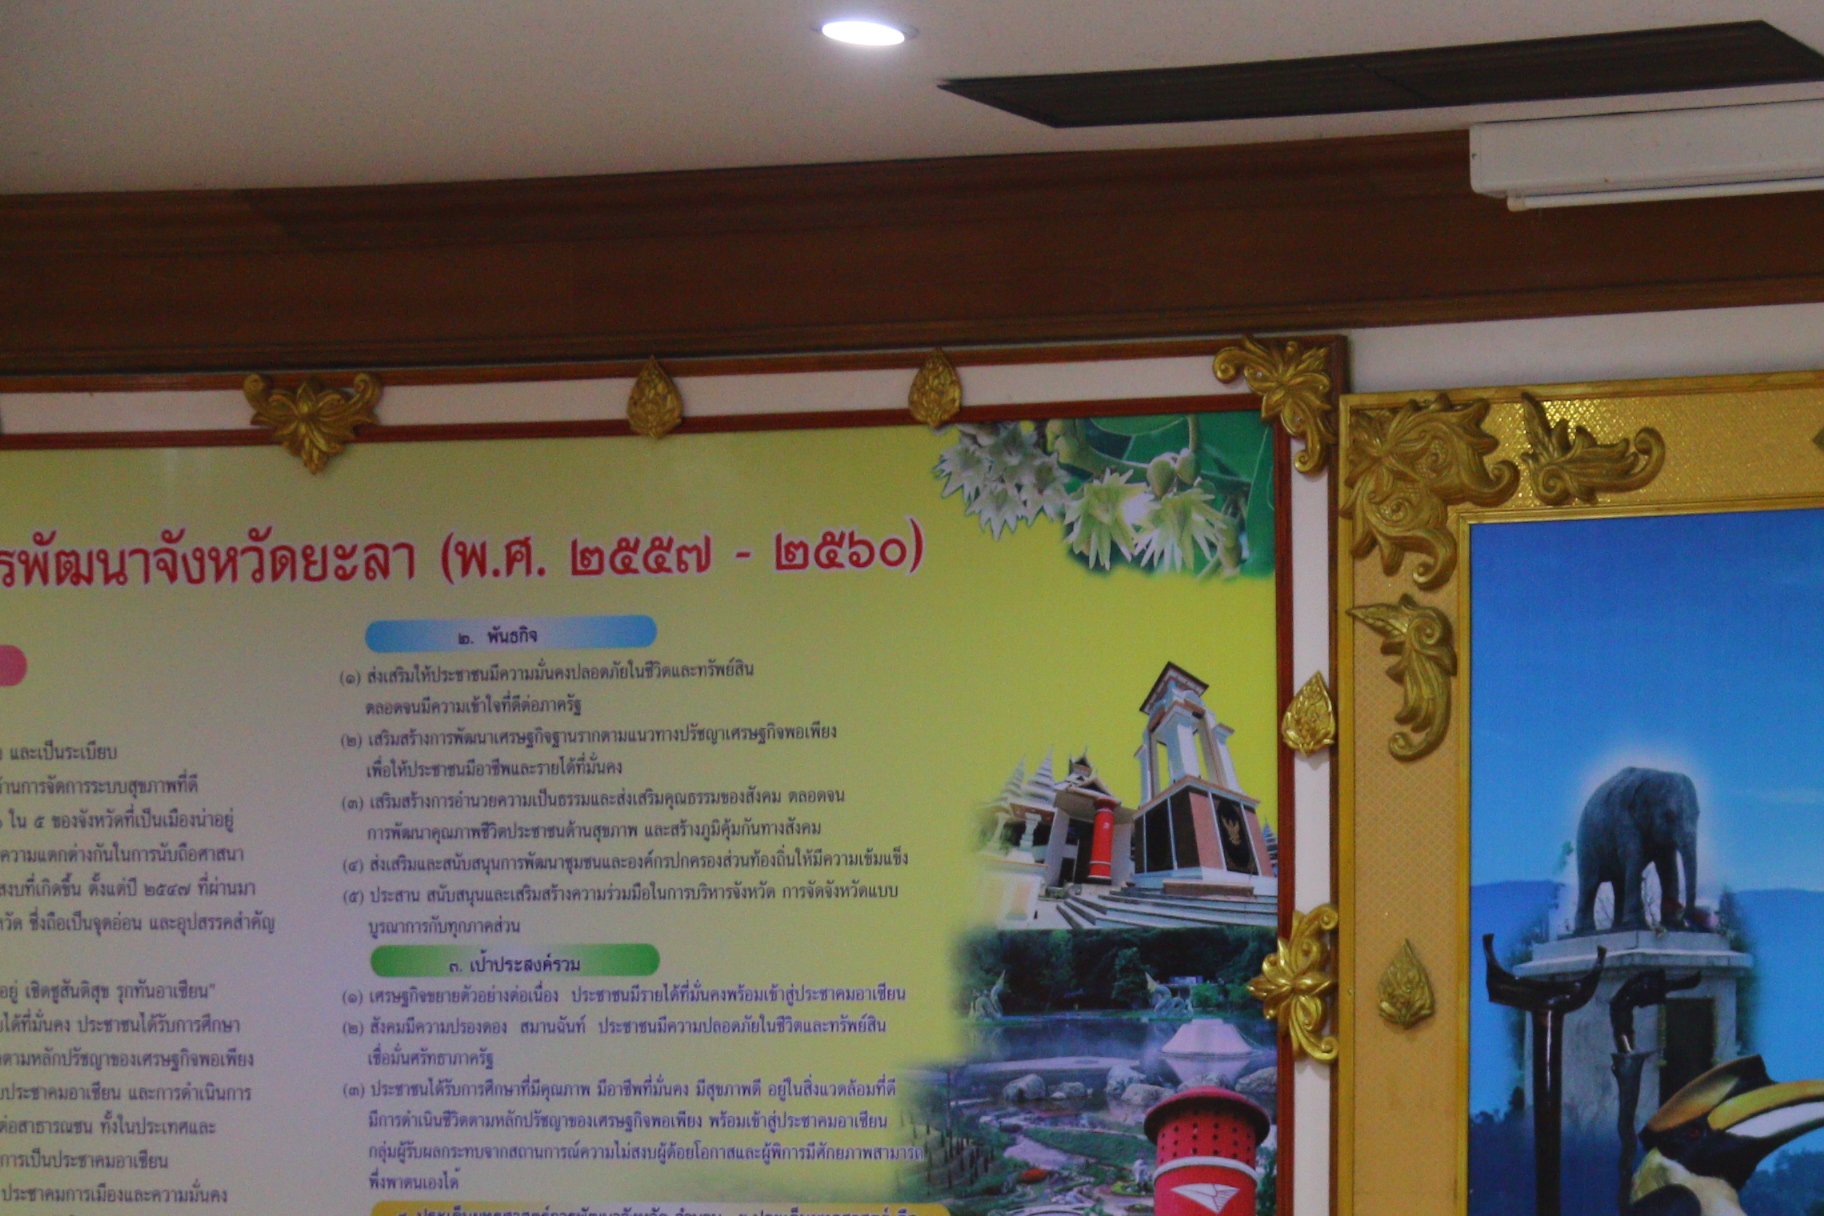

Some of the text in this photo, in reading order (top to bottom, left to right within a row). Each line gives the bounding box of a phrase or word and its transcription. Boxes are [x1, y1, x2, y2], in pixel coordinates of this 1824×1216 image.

[570, 533, 714, 578] ๒๕๕๗
[487, 626, 537, 644] พันธกิจ
[366, 691, 581, 716] ตลอดจนมีความเข้าใจที่ดีต่อภาครัฐ
[10, 739, 117, 760] และเป็นระเบียบ
[367, 753, 622, 778] เพื่อให้ประชาชนมีอาชีพและรายได้ที่มั่นคง
[788, 790, 845, 803] ตลอดจน
[8, 808, 27, 829] ใน
[52, 803, 234, 832] ของจังหวัดที่เป็นเมืองน่าอยู่
[368, 817, 821, 844] การพัฒนาคุณภาพชีวิตประชาชนด้านสุขภาพ และสร้างภูมิคุ้มกันทางสังคม
[88, 873, 137, 896] ตั้งแต่ปี
[197, 872, 256, 896] ที่ผ่านมา
[370, 887, 420, 903] ประสาน
[783, 880, 898, 899] การจัดจังหวัดแบบ
[29, 909, 142, 937] ซึ่งถือเป็นจุดอ่อน
[149, 910, 275, 936] และอุปสรรคสำคัญ
[368, 916, 520, 939] บูรณาการกับทุกภาคส่วน
[470, 949, 580, 972] เป้าประสงค์รวม
[25, 979, 109, 1004] เชิดชูสันติสุข
[370, 982, 559, 1007] เศรษฐกิจขยายตัวอย่างต่อเนื่อง
[77, 1012, 240, 1033] ประชาชนได้รับการศึกษา
[371, 1016, 507, 1034] สังคมมีความปรองดอง
[520, 1015, 586, 1034] สมานฉันท์
[599, 1014, 886, 1034] ประชาชนมีความปลอดภัยในชีวิตและทรัพย์สิน
[0, 1047, 254, 1072] ตามหลักปรัชญาของเศรษฐกิจพอเพียง
[368, 1044, 493, 1070] เชื่อมั่นศรัทธาภาครัฐ
[128, 1082, 251, 1101] และการดำเนินการ
[371, 1074, 590, 1101] ประชาชนได้รับการศึกษาที่มีคุณภาพ
[597, 1074, 689, 1096] มีอาชีพที่มั่นคง
[696, 1078, 761, 1101] มีสุขภาพดี
[768, 1074, 895, 1102] อยู่ในสิ่งแวดล้อมที่ดี
[100, 1110, 216, 1135] ทั้งในประเทศและ
[369, 1109, 887, 1133] มีการดำเนินชีวิตตามหลักปรัชญาของเศรษฐกิจพอเพียง พร้อมเข้าสู่ประชาคมอาเซียน
[0, 1148, 168, 1169] การเป็นประชาคมอาเซียน
[369, 1168, 460, 1189] พึ่งพาตนเองได้
[1, 1179, 228, 1203] ประชาคมการเมืองและความมั่นคง
